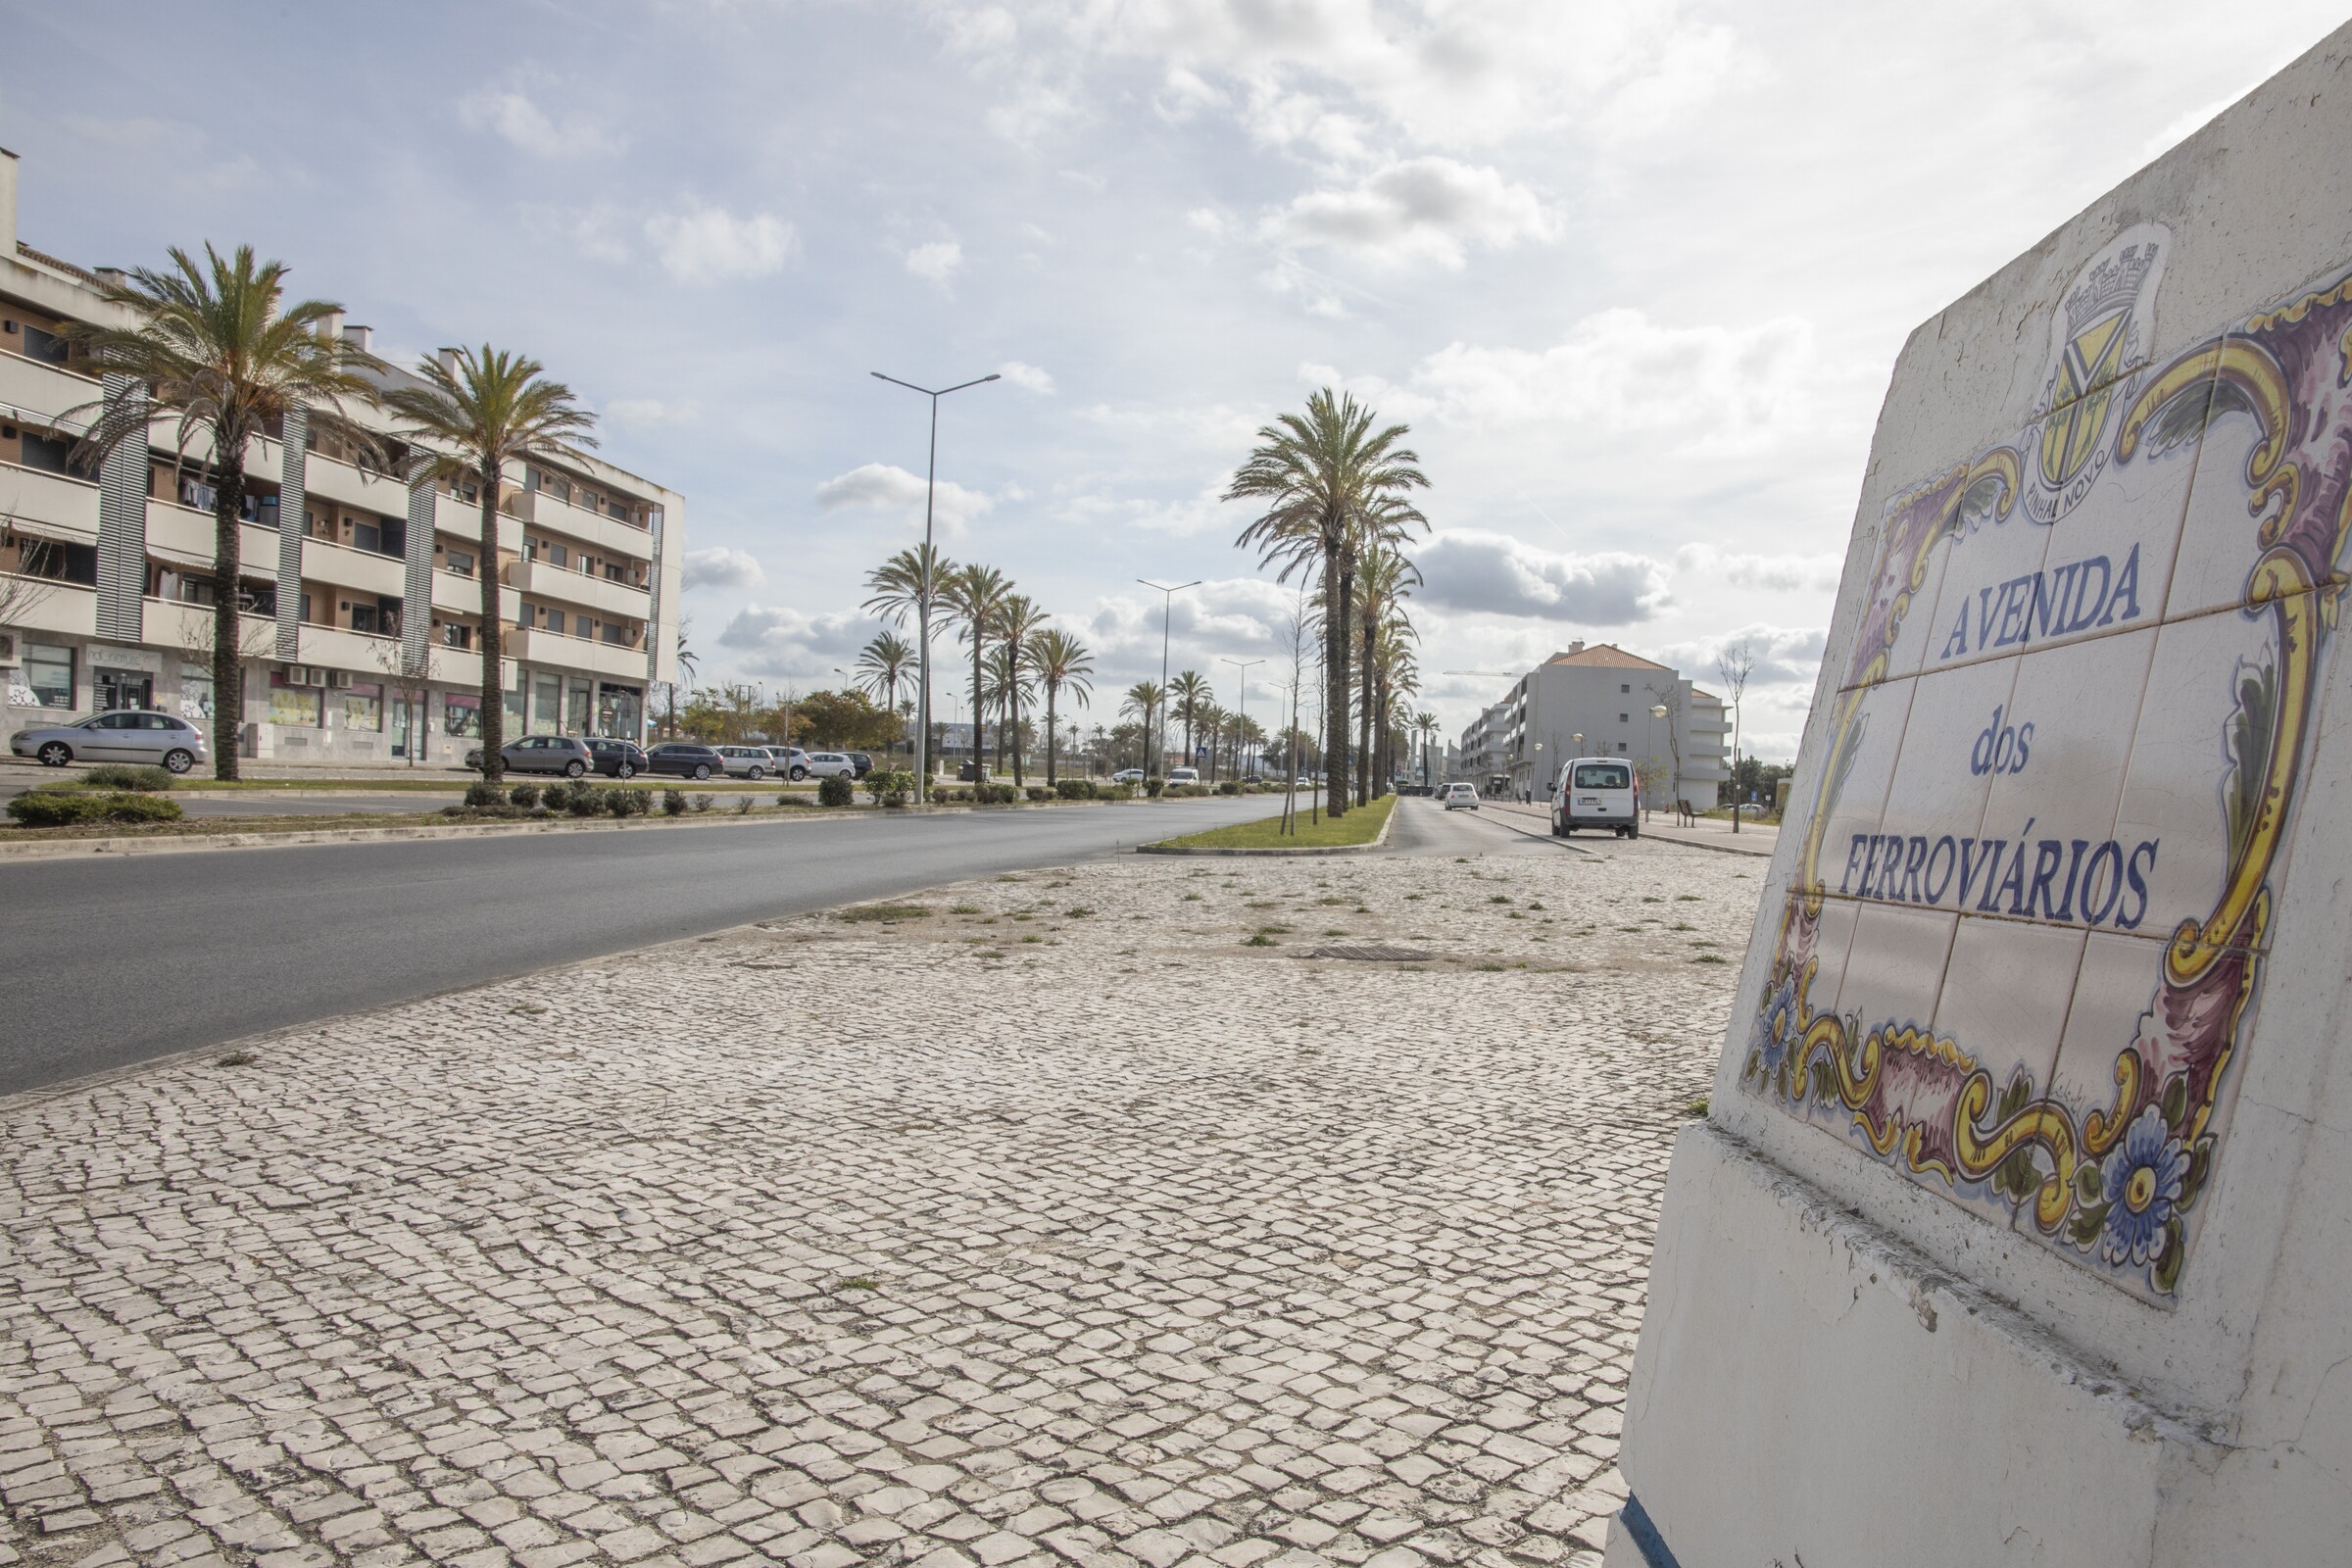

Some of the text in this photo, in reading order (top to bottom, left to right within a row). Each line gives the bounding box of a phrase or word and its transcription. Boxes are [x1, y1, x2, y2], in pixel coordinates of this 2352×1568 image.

[2026, 450, 2105, 520] PINHAL NOVO
[1939, 541, 2141, 660] AVENIDA
[1970, 704, 2035, 777] dos
[1838, 817, 2160, 930] FERROVIÁRIOS
